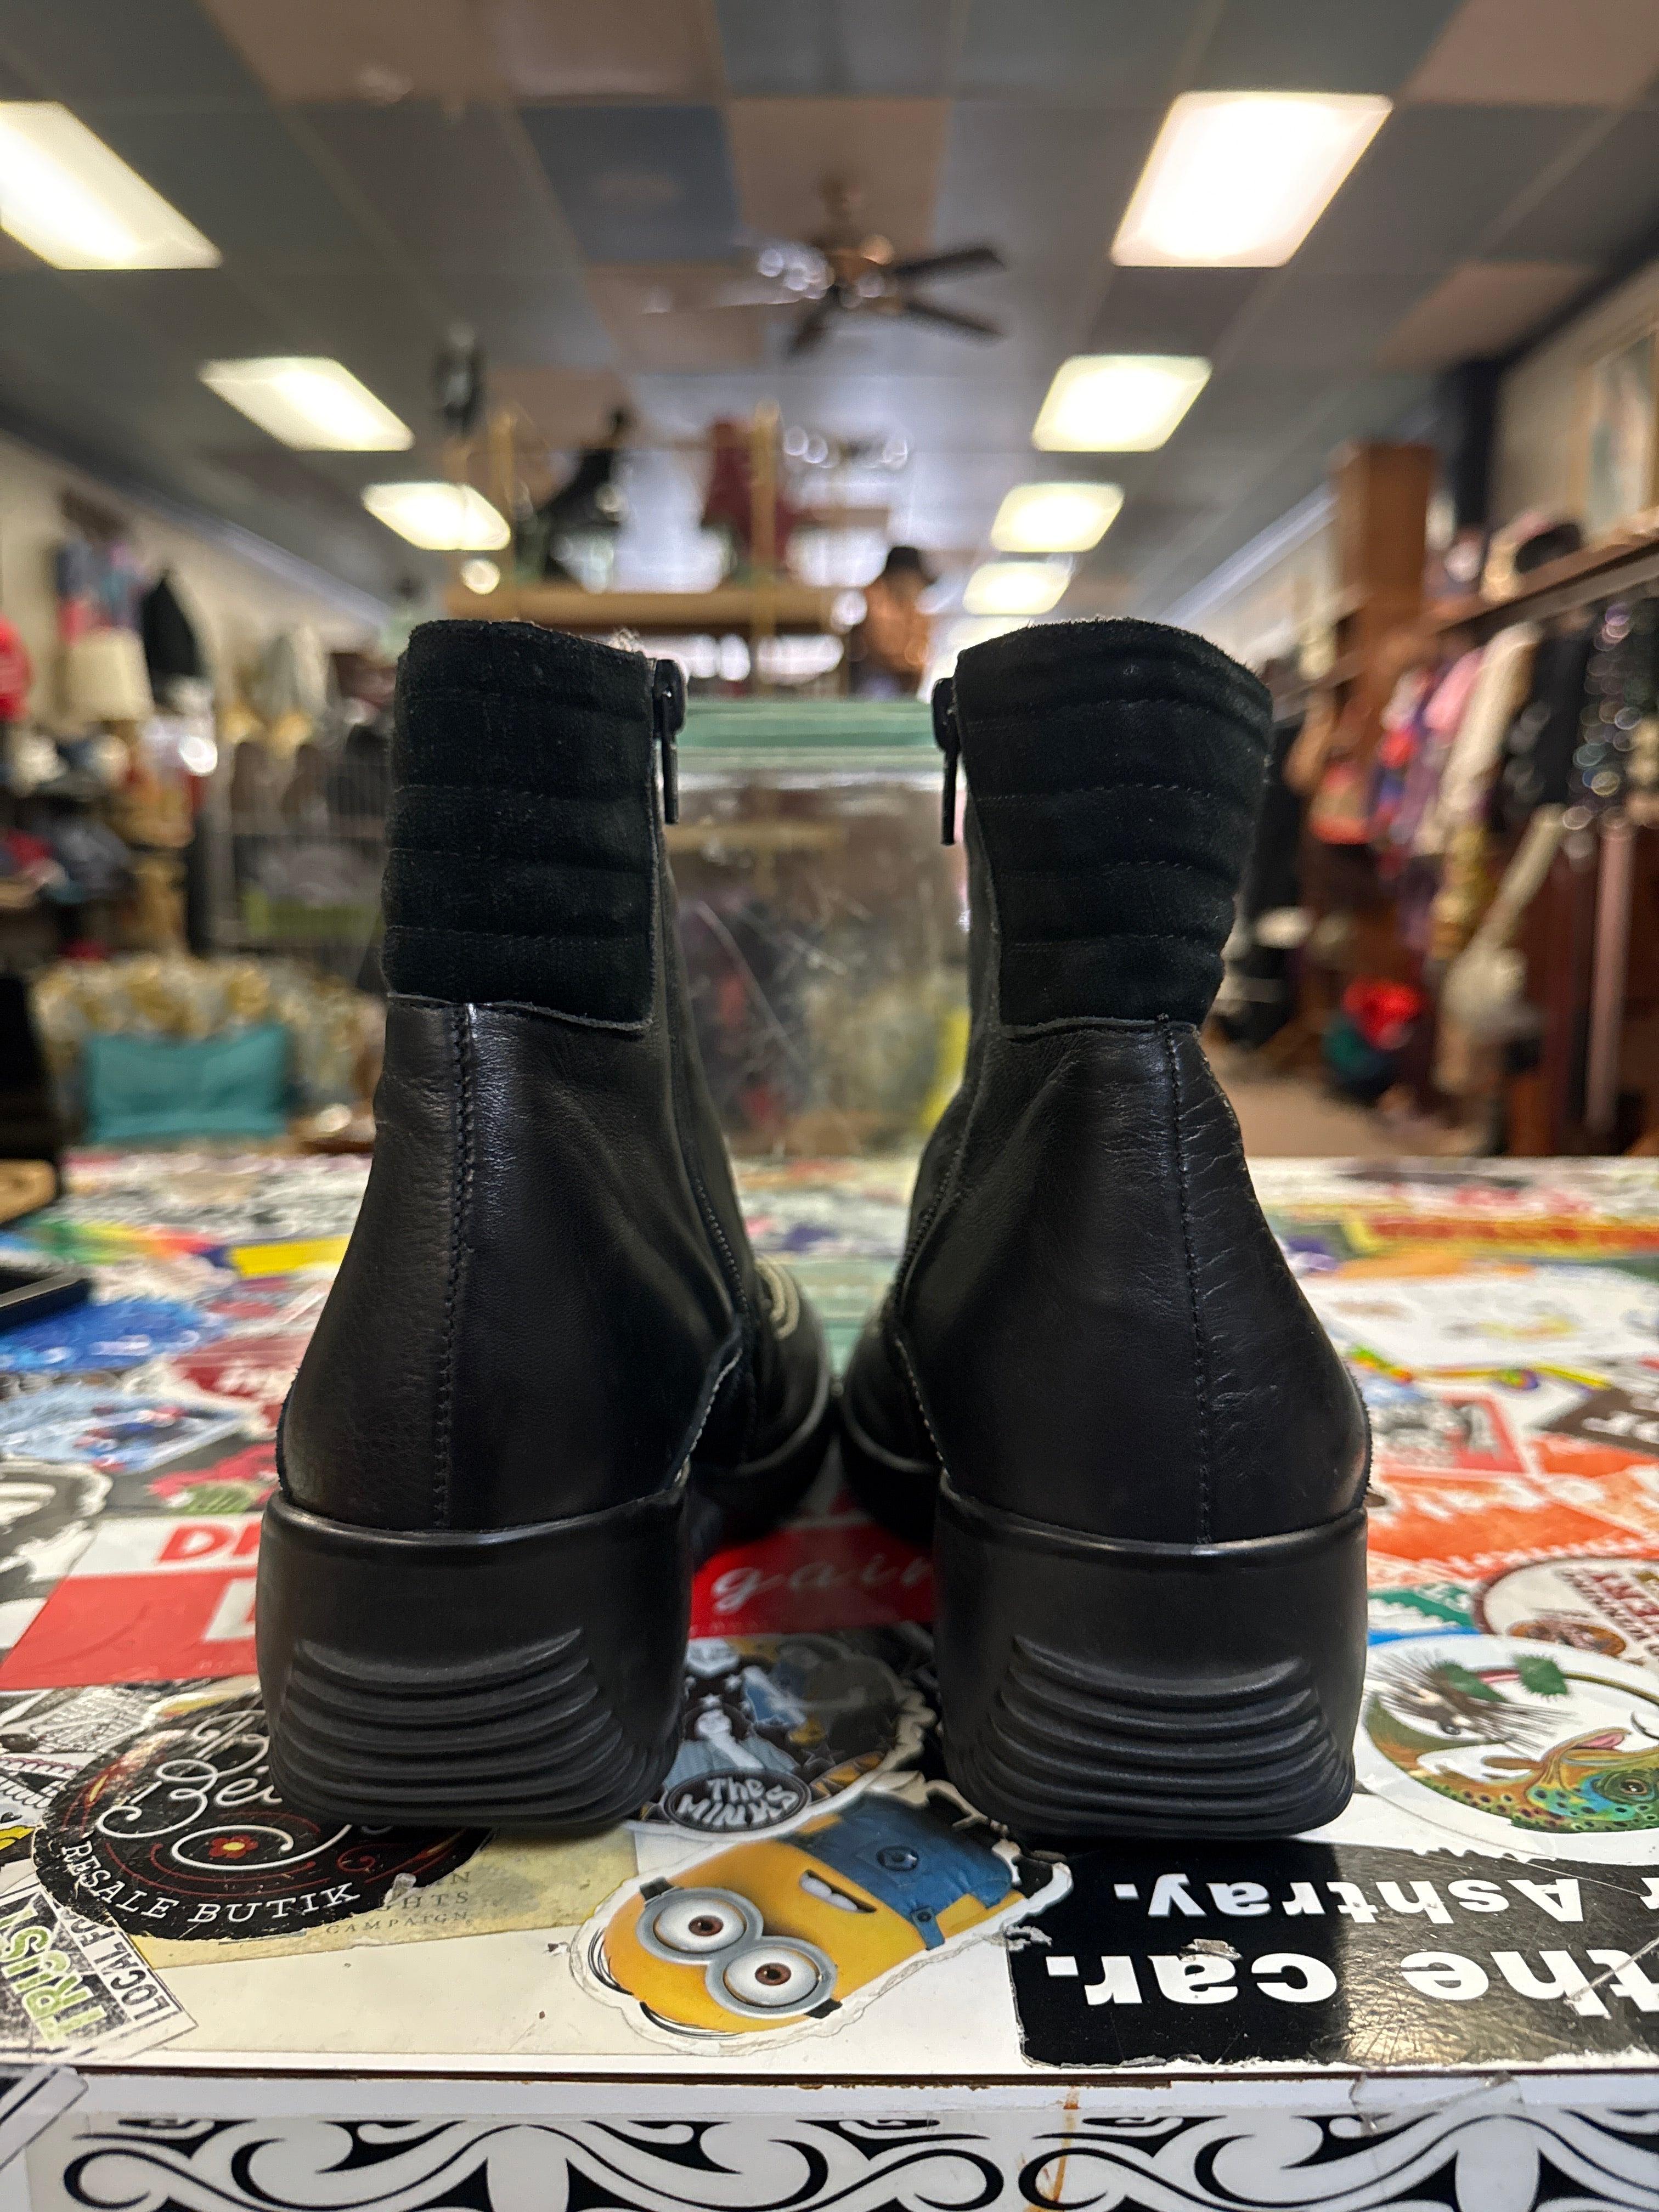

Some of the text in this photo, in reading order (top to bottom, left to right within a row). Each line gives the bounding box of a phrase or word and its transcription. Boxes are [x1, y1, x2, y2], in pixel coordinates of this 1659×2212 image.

[707, 1777, 766, 1802] The
[61, 1840, 361, 1923] RESALE BUTIK
[1113, 1873, 1584, 1924] Ashtray.
[326, 1911, 467, 1934] CAMPAIGN
[94, 1942, 171, 2022] LOCAL
[1046, 1949, 1659, 2018] the car.
